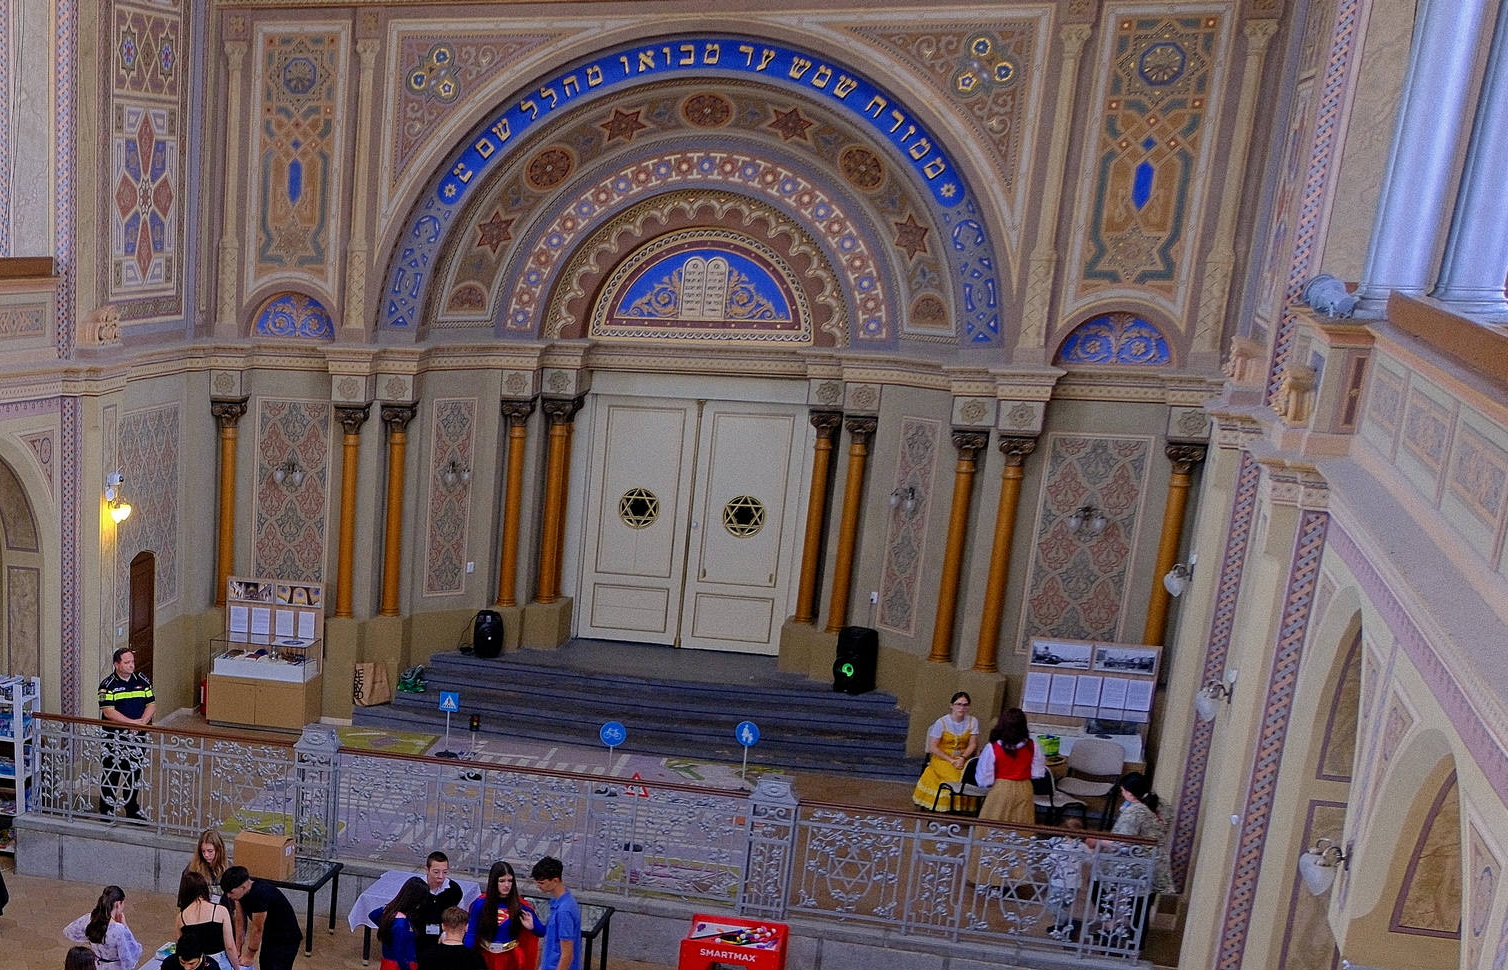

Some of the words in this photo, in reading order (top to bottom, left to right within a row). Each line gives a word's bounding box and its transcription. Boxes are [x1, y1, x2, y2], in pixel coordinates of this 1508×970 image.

[620, 43, 720, 75] מבואו
[789, 57, 857, 98] שמש
[520, 65, 603, 120] מהלל
[475, 118, 511, 159] שם
[699, 948, 756, 962] SMARTMAX
